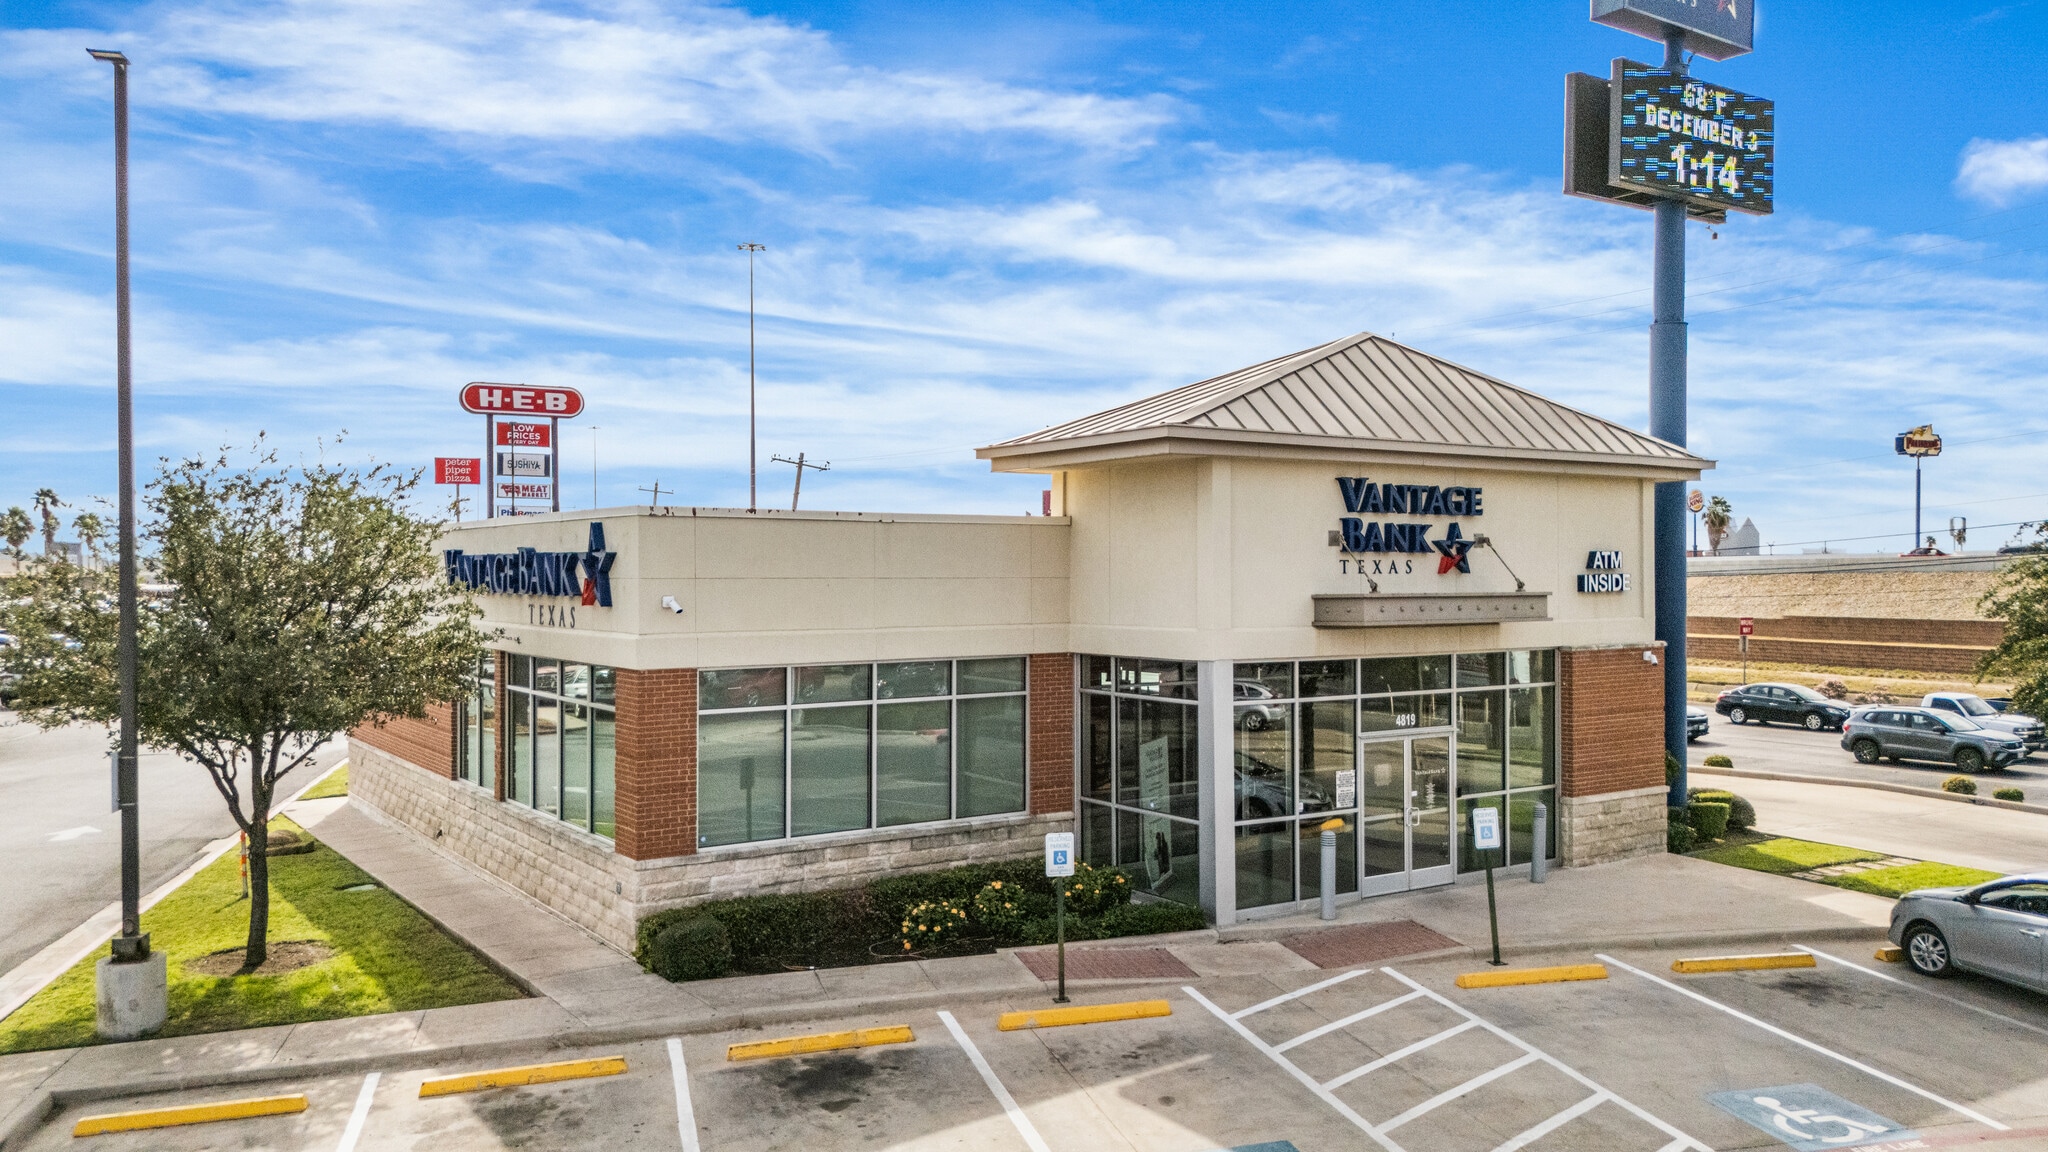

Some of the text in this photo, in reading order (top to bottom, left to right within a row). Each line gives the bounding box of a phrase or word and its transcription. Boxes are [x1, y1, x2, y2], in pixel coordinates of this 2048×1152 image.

[1645, 103, 1745, 149] DECEMBER
[1670, 143, 1739, 194] 1:14
[479, 388, 568, 411] H-E-B
[507, 431, 541, 441] PRICES
[513, 424, 535, 432] LOW
[445, 458, 472, 467] peter
[445, 466, 472, 476] piper
[445, 475, 472, 484] pizza
[521, 484, 548, 493] MEAT
[1335, 476, 1484, 516] VANTAGE
[1339, 517, 1435, 553] BANK
[1339, 559, 1413, 575] TEXAS
[1588, 551, 1623, 569] ATM
[1580, 573, 1632, 592] INSIDE
[528, 603, 576, 629] TEXAS
[1395, 713, 1416, 726] 4819
